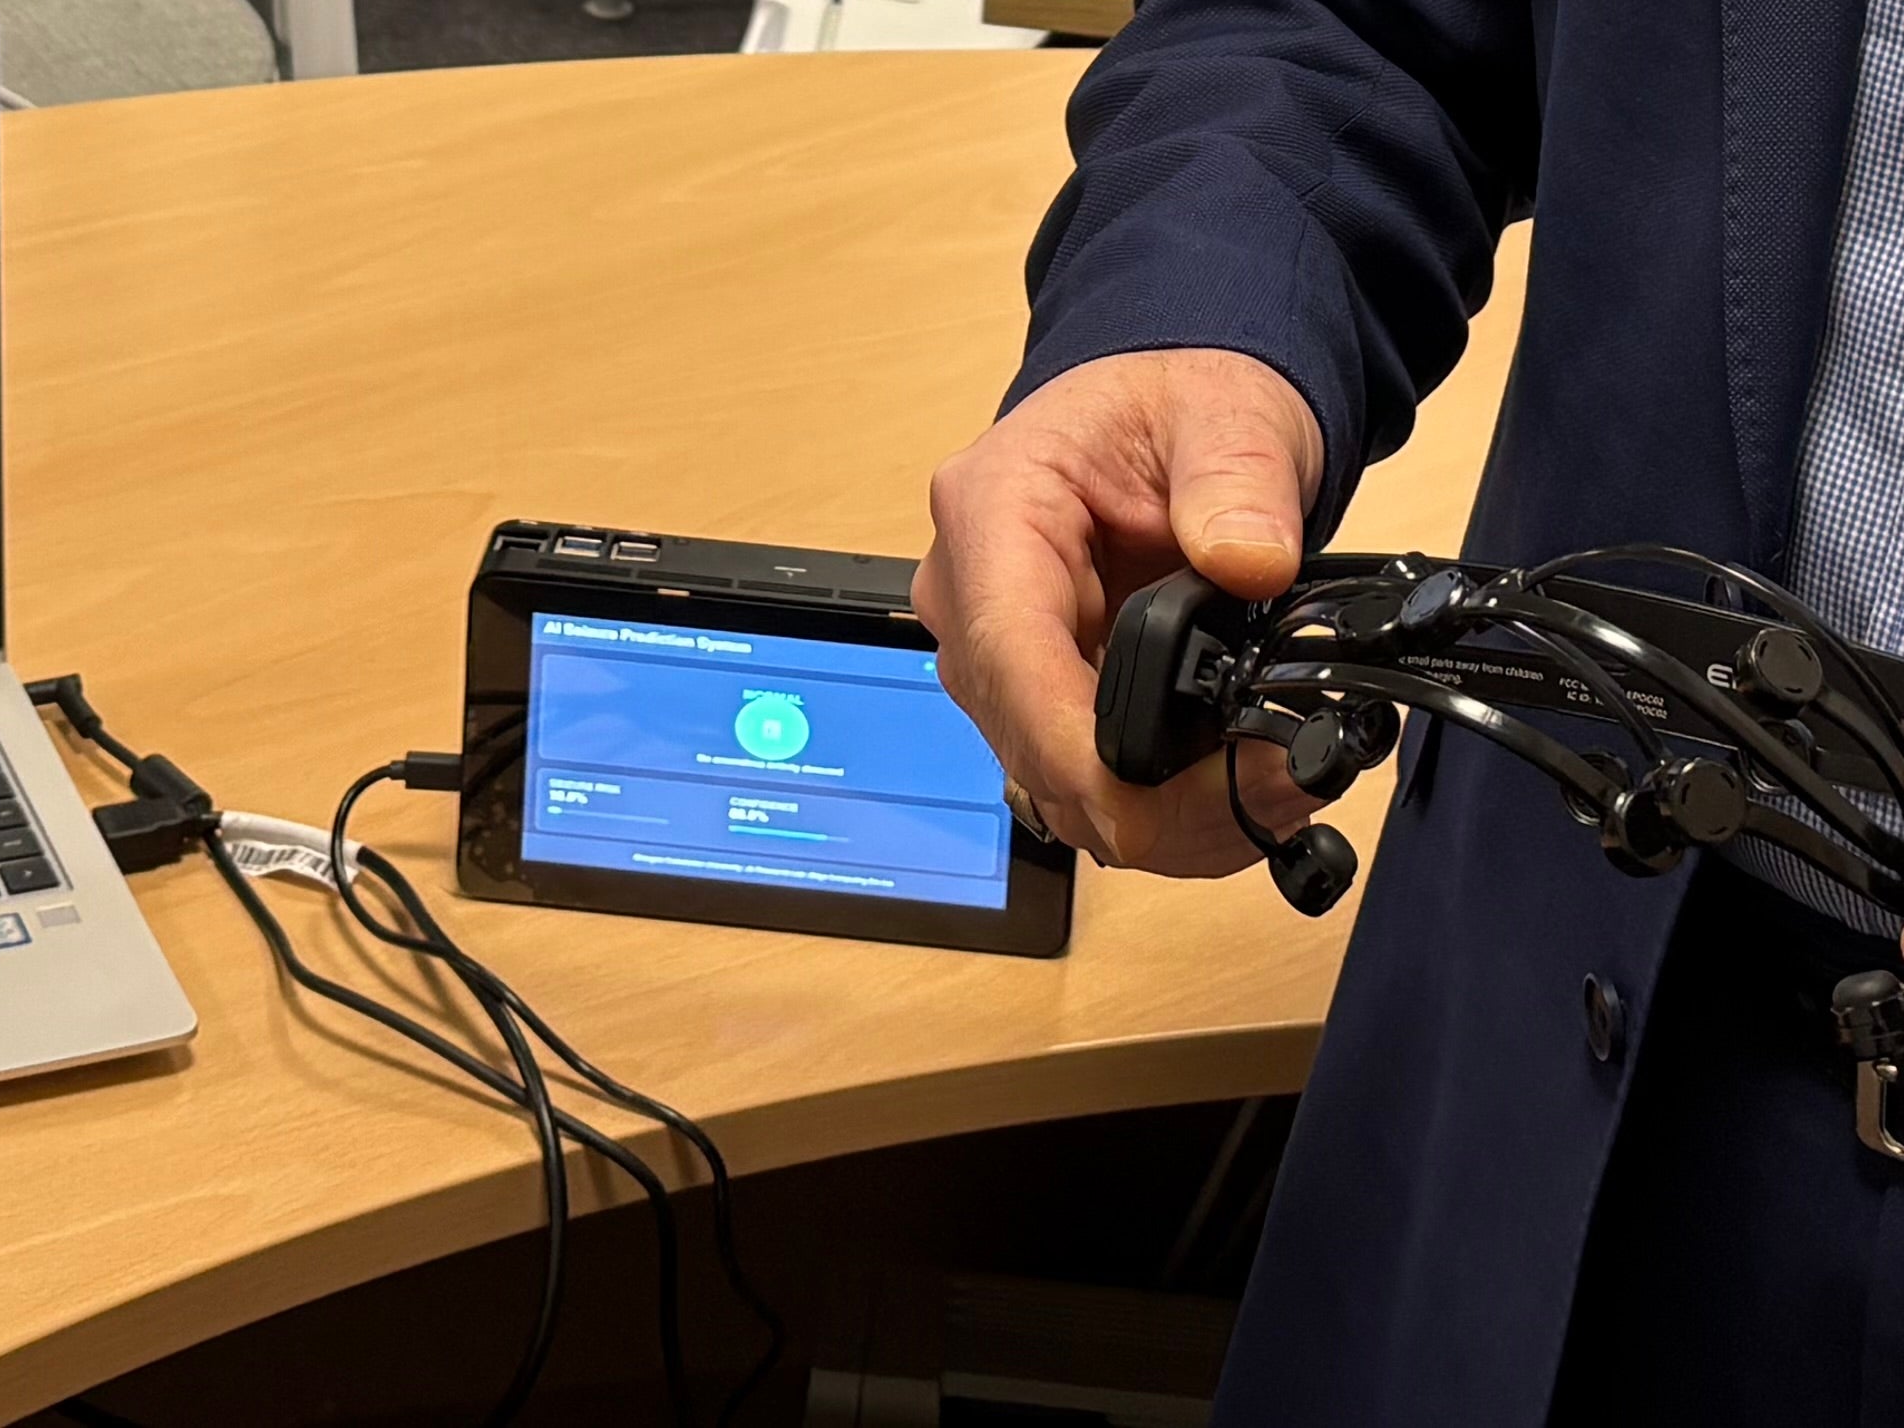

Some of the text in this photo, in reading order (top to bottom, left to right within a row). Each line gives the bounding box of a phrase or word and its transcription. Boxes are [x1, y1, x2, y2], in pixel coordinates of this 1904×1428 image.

[1455, 661, 1480, 673] away
[1482, 663, 1503, 675] from
[1505, 667, 1544, 681] children
[1559, 677, 1579, 689] FCC
